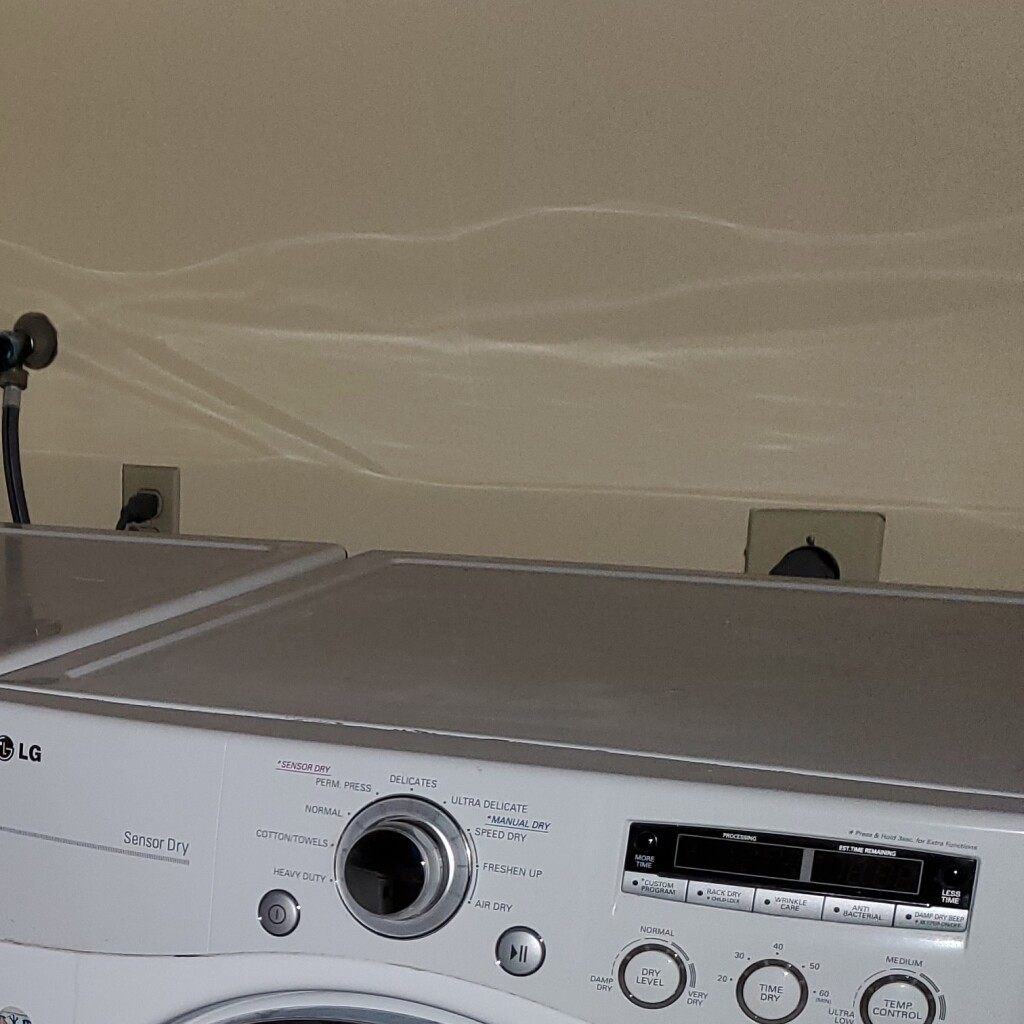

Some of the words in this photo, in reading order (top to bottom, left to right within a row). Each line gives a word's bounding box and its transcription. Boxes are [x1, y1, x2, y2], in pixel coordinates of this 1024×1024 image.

[18, 742, 42, 762] LG
[314, 765, 332, 774] DRY
[316, 777, 342, 789] PERM.
[344, 781, 372, 793] PRESS
[389, 774, 438, 789] DELICATES
[451, 795, 481, 808] ULTRA
[483, 799, 528, 813] DELICATE
[304, 804, 343, 818] NORMAL
[531, 820, 552, 831] DRY
[256, 829, 328, 848] COTTON/TOWELS
[474, 828, 504, 839] SPEED
[507, 831, 527, 843] DRY
[723, 832, 757, 842] PROCESSING
[123, 830, 165, 849] Sensor
[167, 837, 190, 857] Dry
[926, 839, 944, 847] Extra
[945, 841, 978, 850] Functions
[864, 848, 896, 857] REMAINING
[634, 854, 655, 863] MORE
[483, 862, 526, 876] FRESHEN
[529, 868, 543, 878] UP
[636, 861, 652, 869] TIME
[273, 867, 301, 879] HEAVY
[302, 872, 326, 884] DUTY
[644, 880, 674, 889] CUSTOM
[641, 886, 676, 895] PROGRAM
[707, 889, 726, 897] RACK
[727, 890, 742, 898] DRY
[941, 889, 961, 898] LESS
[775, 896, 807, 907] WRINKLE
[941, 896, 959, 905] TIME
[474, 900, 491, 911] AIR
[494, 902, 513, 913] DRY
[781, 904, 800, 912] CARE
[852, 904, 870, 912] ANTI
[843, 910, 883, 921] BACTERIAL
[914, 911, 934, 920] DAMP
[934, 913, 948, 921] DRY
[948, 914, 965, 922] BEEP
[640, 925, 675, 937] NORMAL
[773, 943, 784, 951] 40
[734, 952, 745, 960] 30
[809, 962, 820, 970] 50
[886, 955, 923, 968] MEDIUM
[641, 968, 662, 978] DRY
[717, 974, 728, 982] 20
[590, 975, 614, 985] DAMP
[636, 976, 664, 987] LEVEL
[596, 983, 613, 993] DRY
[759, 983, 784, 994] TIME
[688, 990, 709, 1000] VERY
[760, 993, 781, 1002] DRY
[819, 989, 830, 998] 60
[687, 998, 703, 1006] DRY
[828, 1007, 855, 1018] ULTRA
[872, 1007, 923, 1020] CONTROL
